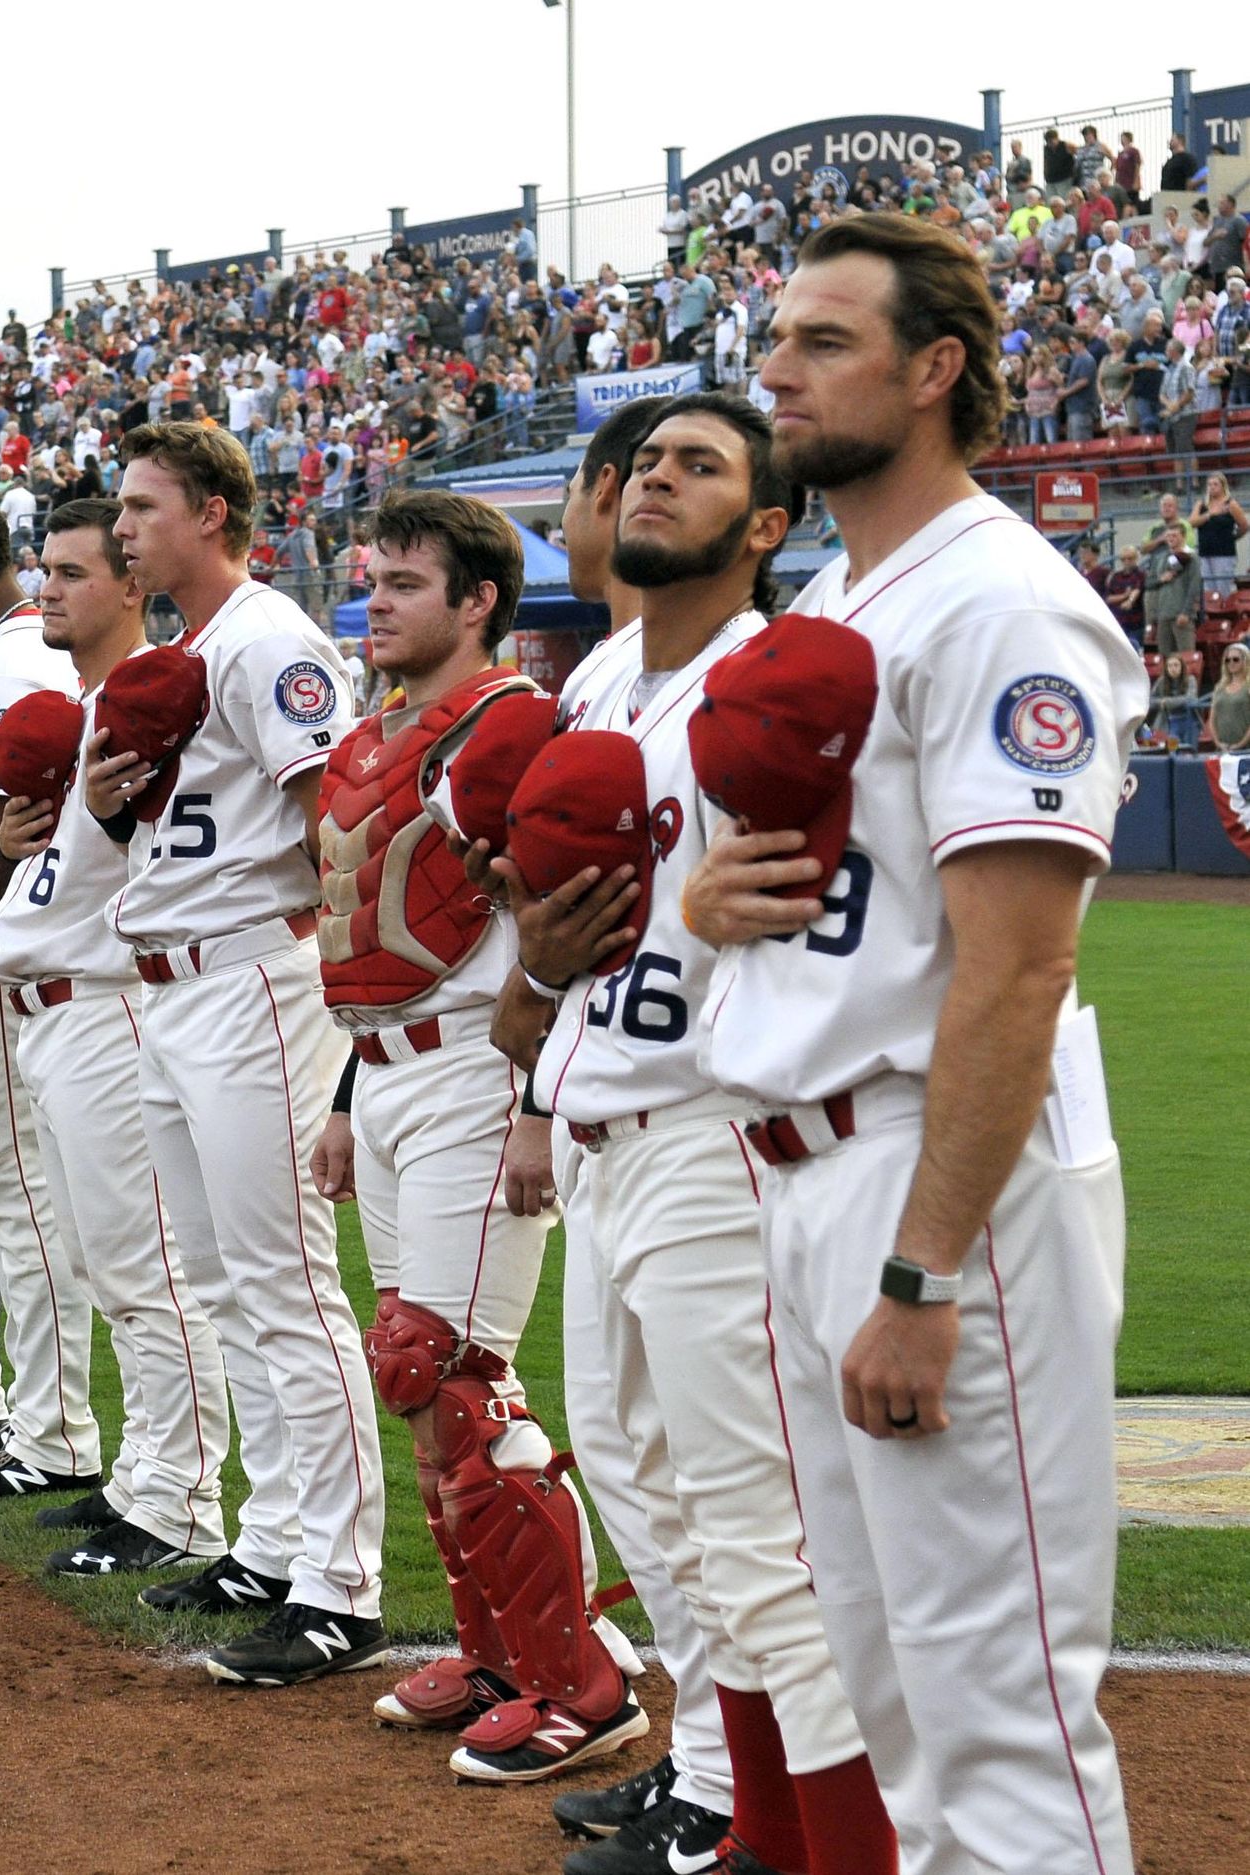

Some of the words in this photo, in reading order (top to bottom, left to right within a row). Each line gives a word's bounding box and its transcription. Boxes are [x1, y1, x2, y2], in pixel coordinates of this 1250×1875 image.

[699, 157, 761, 206] RIM
[770, 143, 813, 177] OF
[1031, 702, 1068, 750] S
[587, 951, 688, 1043] 36
